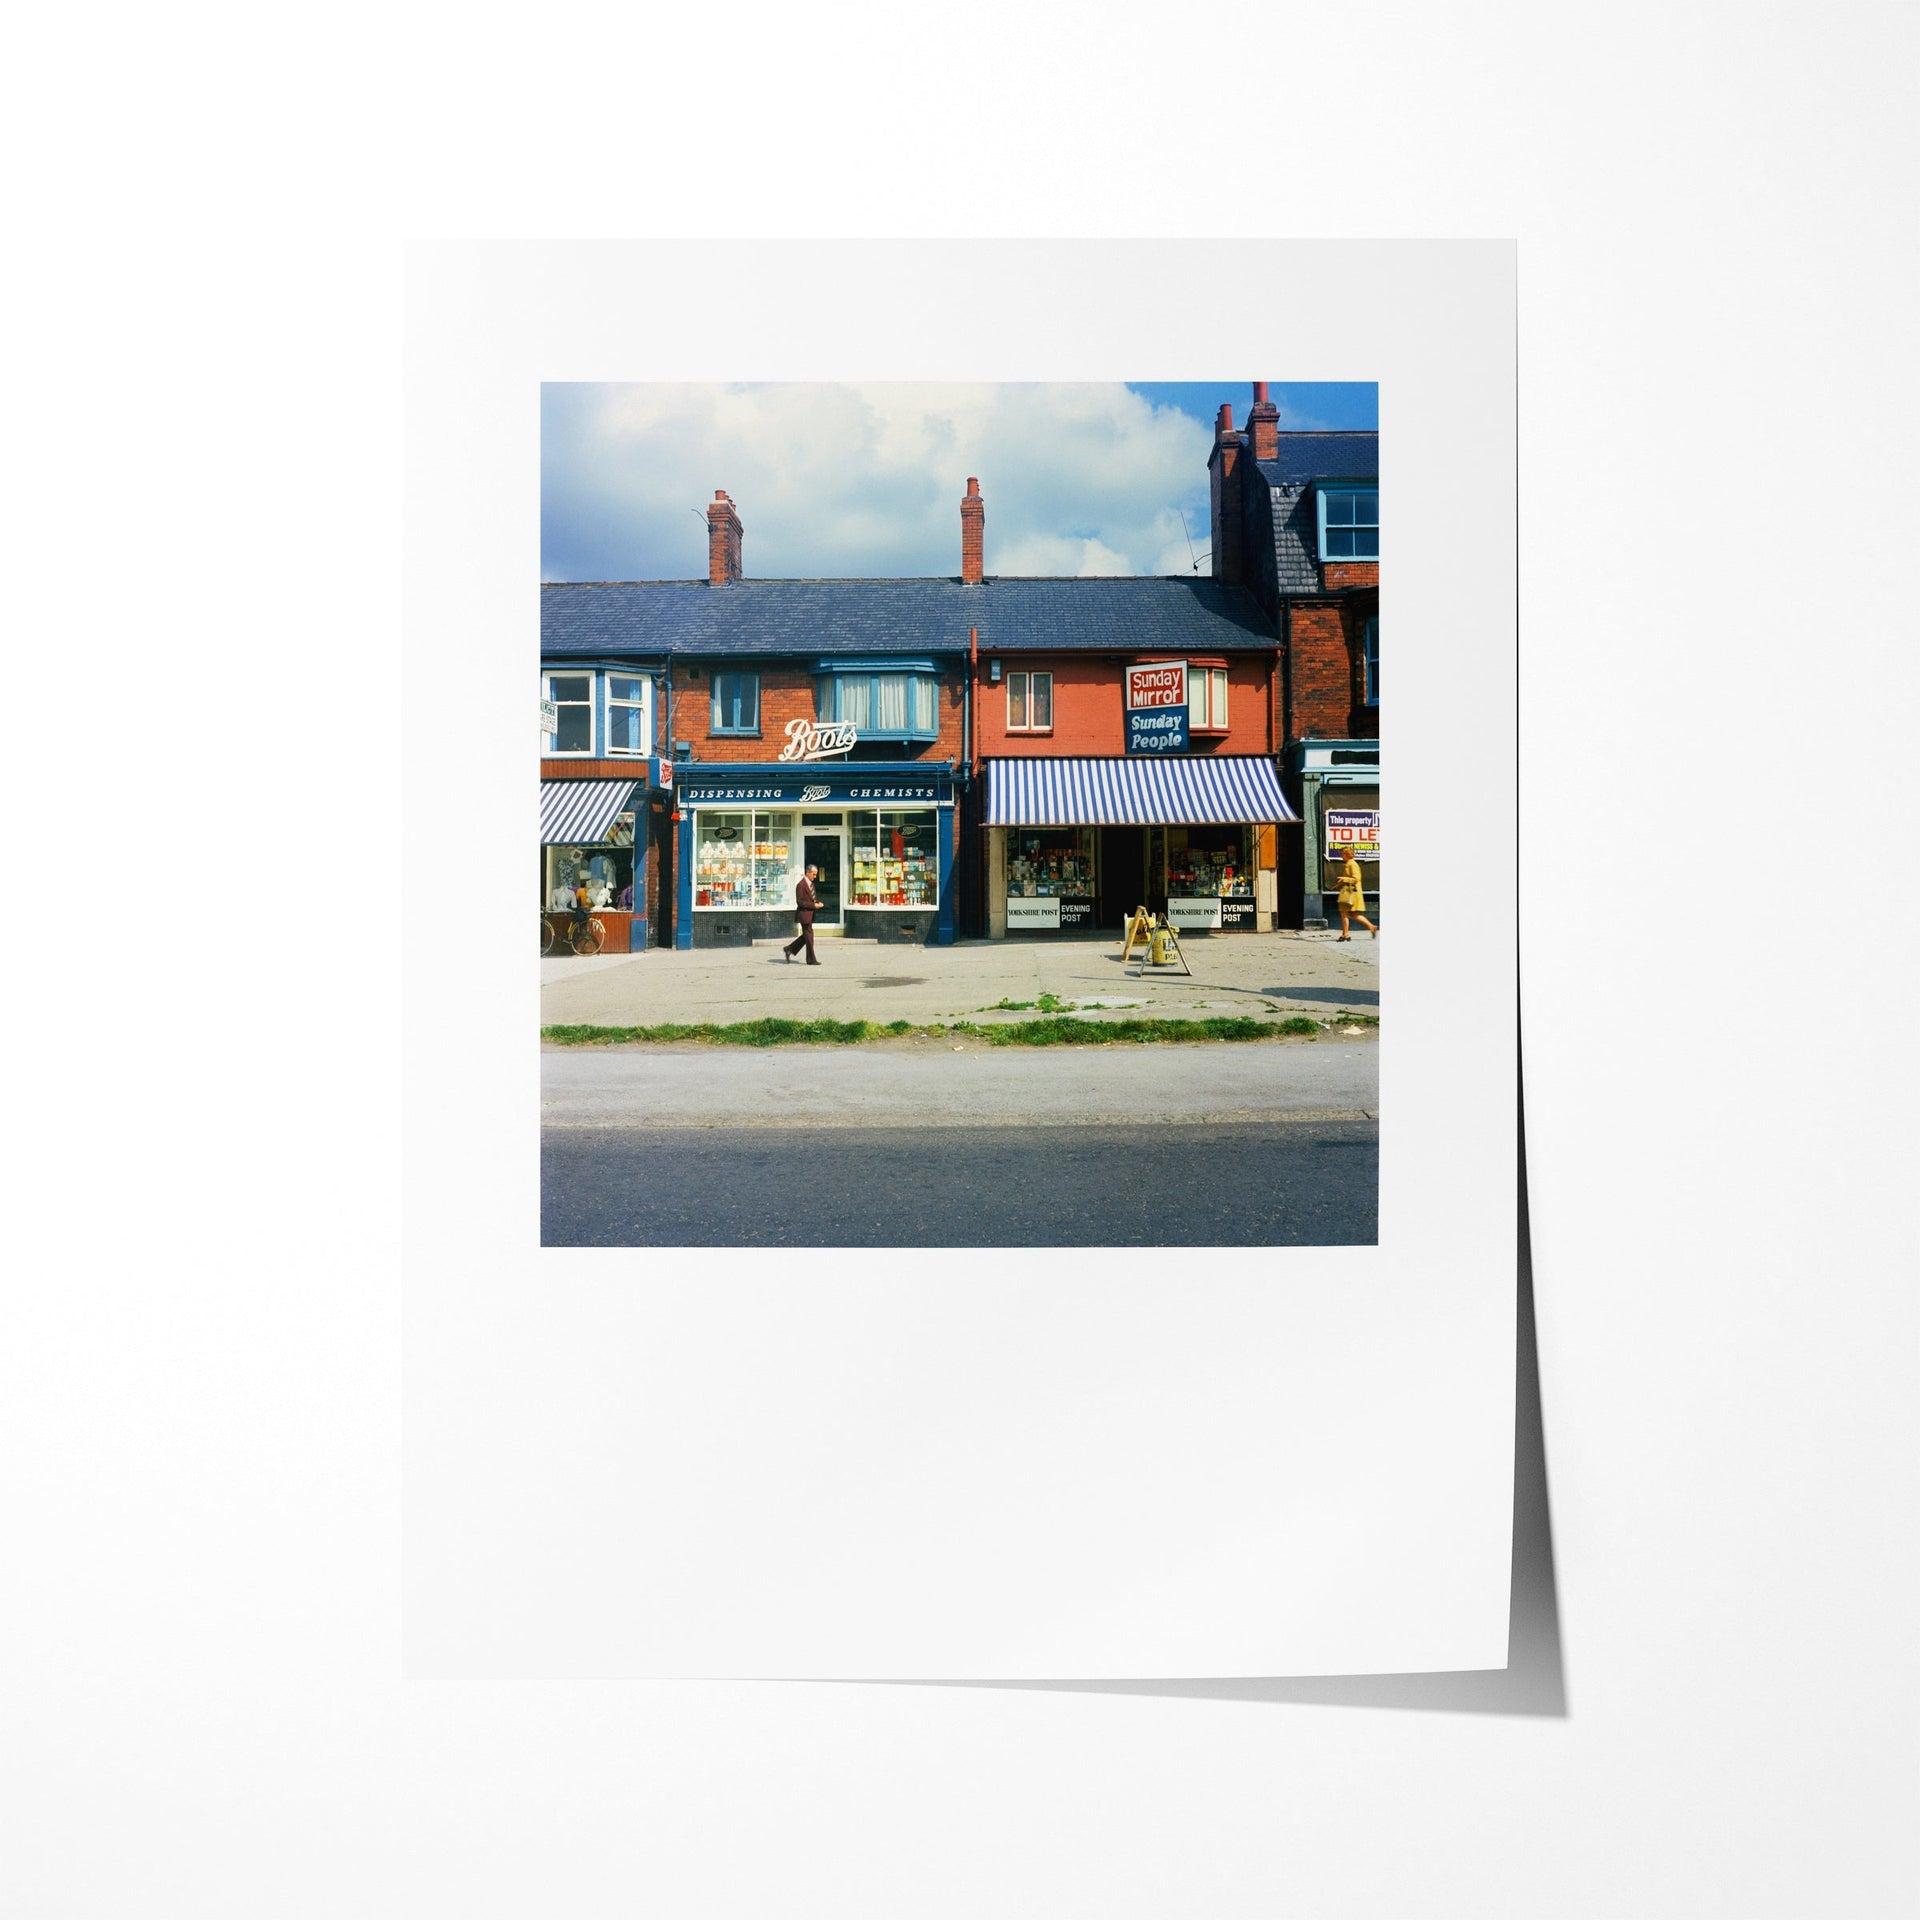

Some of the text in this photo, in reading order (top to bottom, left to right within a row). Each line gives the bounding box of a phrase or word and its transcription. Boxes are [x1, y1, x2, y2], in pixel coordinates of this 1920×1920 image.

[1133, 670, 1181, 689] Sunday
[1133, 688, 1180, 706] Mirror
[1131, 714, 1182, 731] Sunday
[778, 718, 858, 762] Boots
[1131, 732, 1182, 750] People
[689, 785, 934, 802] DISPENSING Boots CHEMISTS
[1330, 816, 1344, 824] This
[1345, 817, 1372, 826] property
[1329, 828, 1380, 841] TO LE
[1223, 904, 1254, 912] EVENING
[1061, 914, 1081, 922] POST
[1223, 914, 1241, 922] POST
